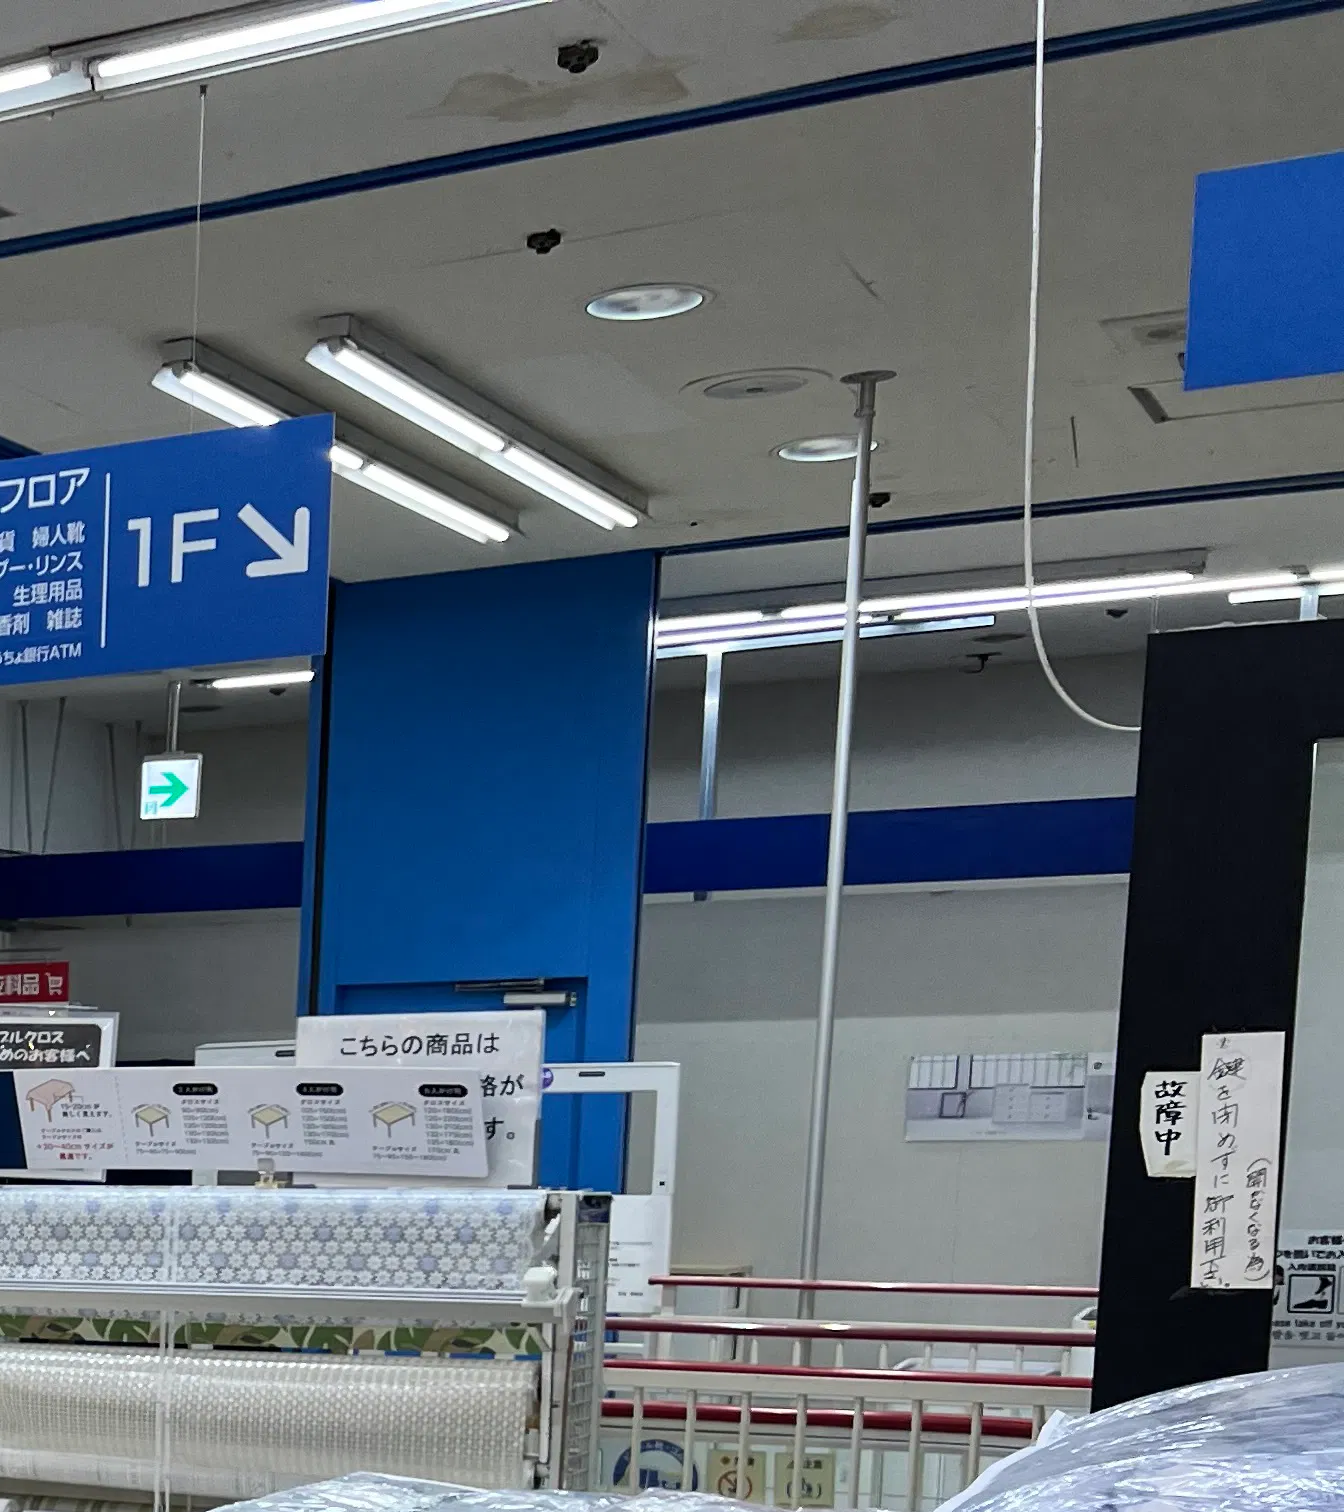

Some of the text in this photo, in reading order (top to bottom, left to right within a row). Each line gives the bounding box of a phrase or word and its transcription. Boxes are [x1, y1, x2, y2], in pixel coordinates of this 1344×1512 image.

[32, 521, 86, 549] 婦人靴
[127, 507, 220, 588] 1F
[13, 578, 83, 608] 生理用品
[46, 606, 83, 631] 雑誌
[340, 1032, 501, 1057] こちらの商品は
[1155, 1080, 1188, 1155] 故障中
